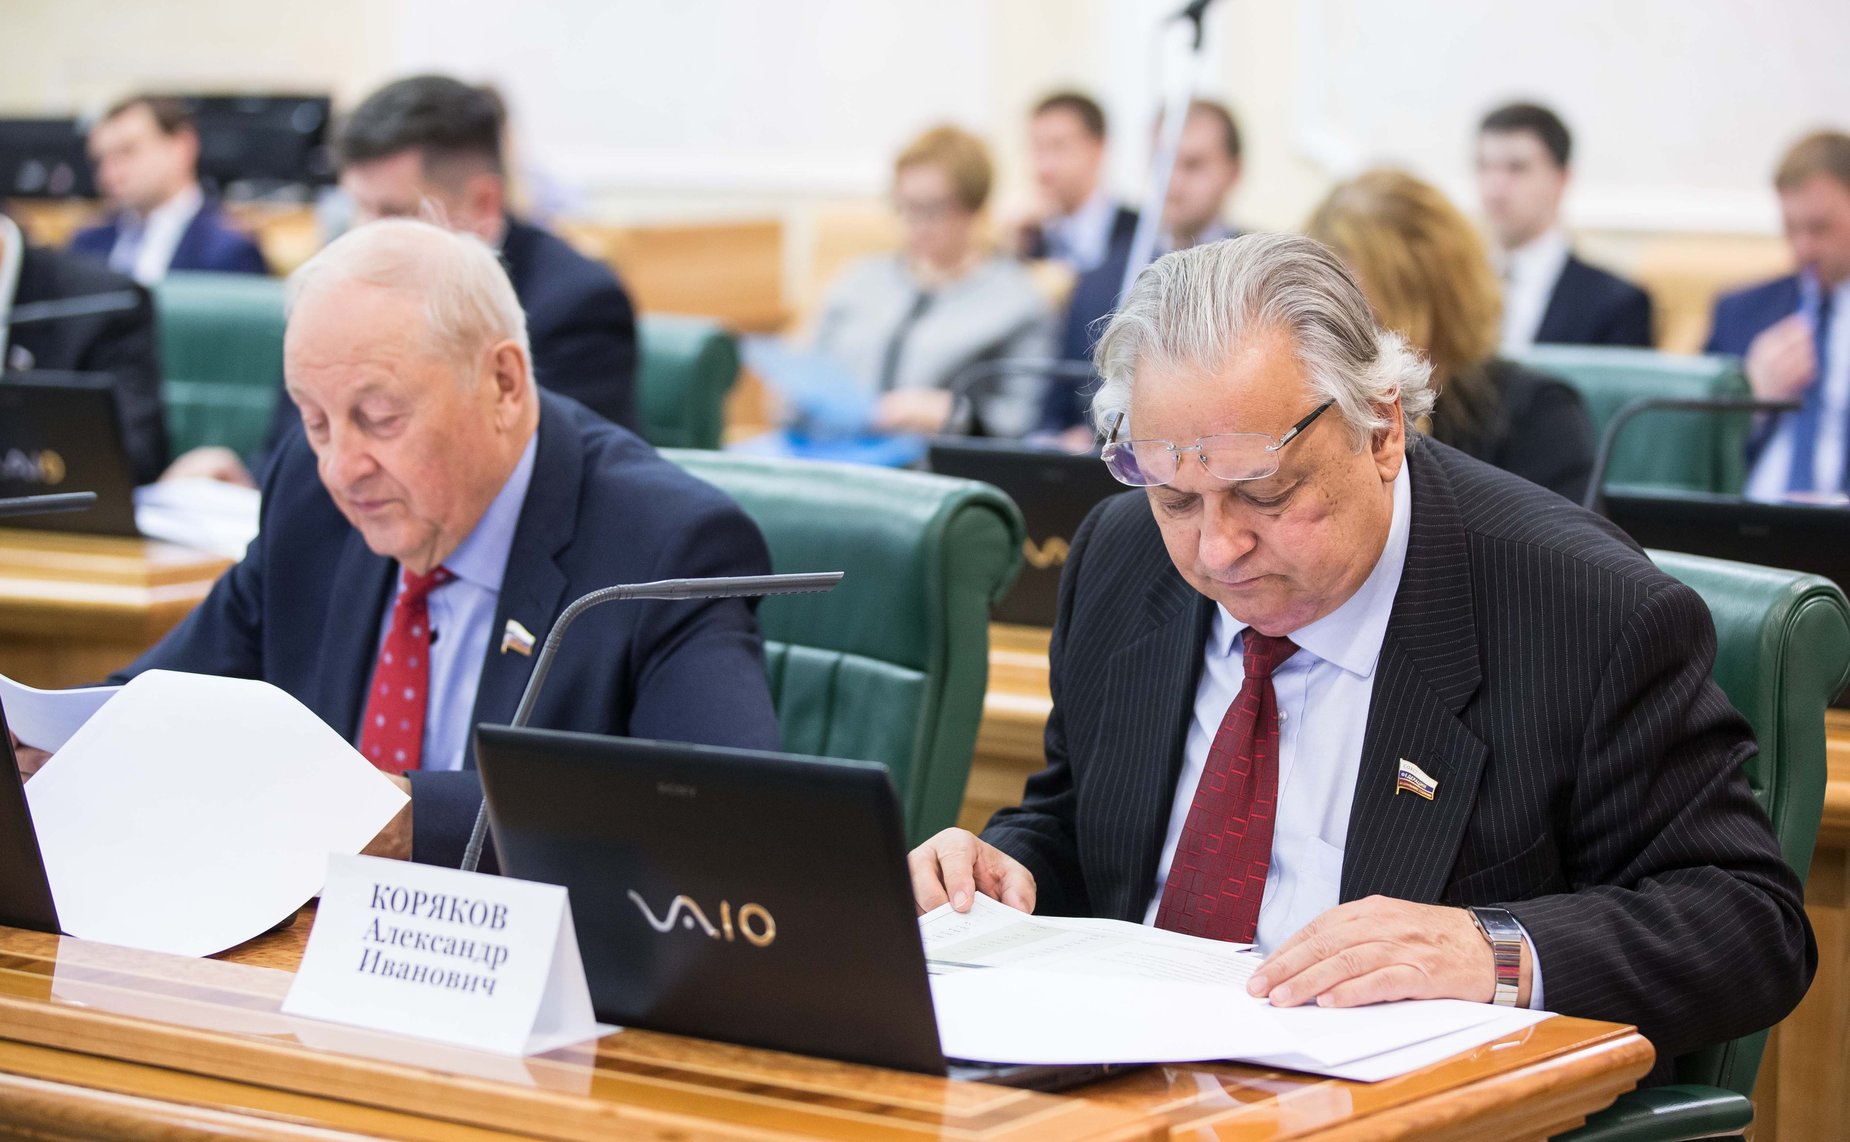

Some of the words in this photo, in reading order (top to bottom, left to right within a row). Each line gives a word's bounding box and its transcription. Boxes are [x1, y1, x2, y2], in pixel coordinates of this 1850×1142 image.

[370, 882, 509, 931] КОРЯКОВ
[627, 888, 776, 947] VAIO
[362, 917, 509, 970] Александр
[357, 947, 498, 997] Иванович
